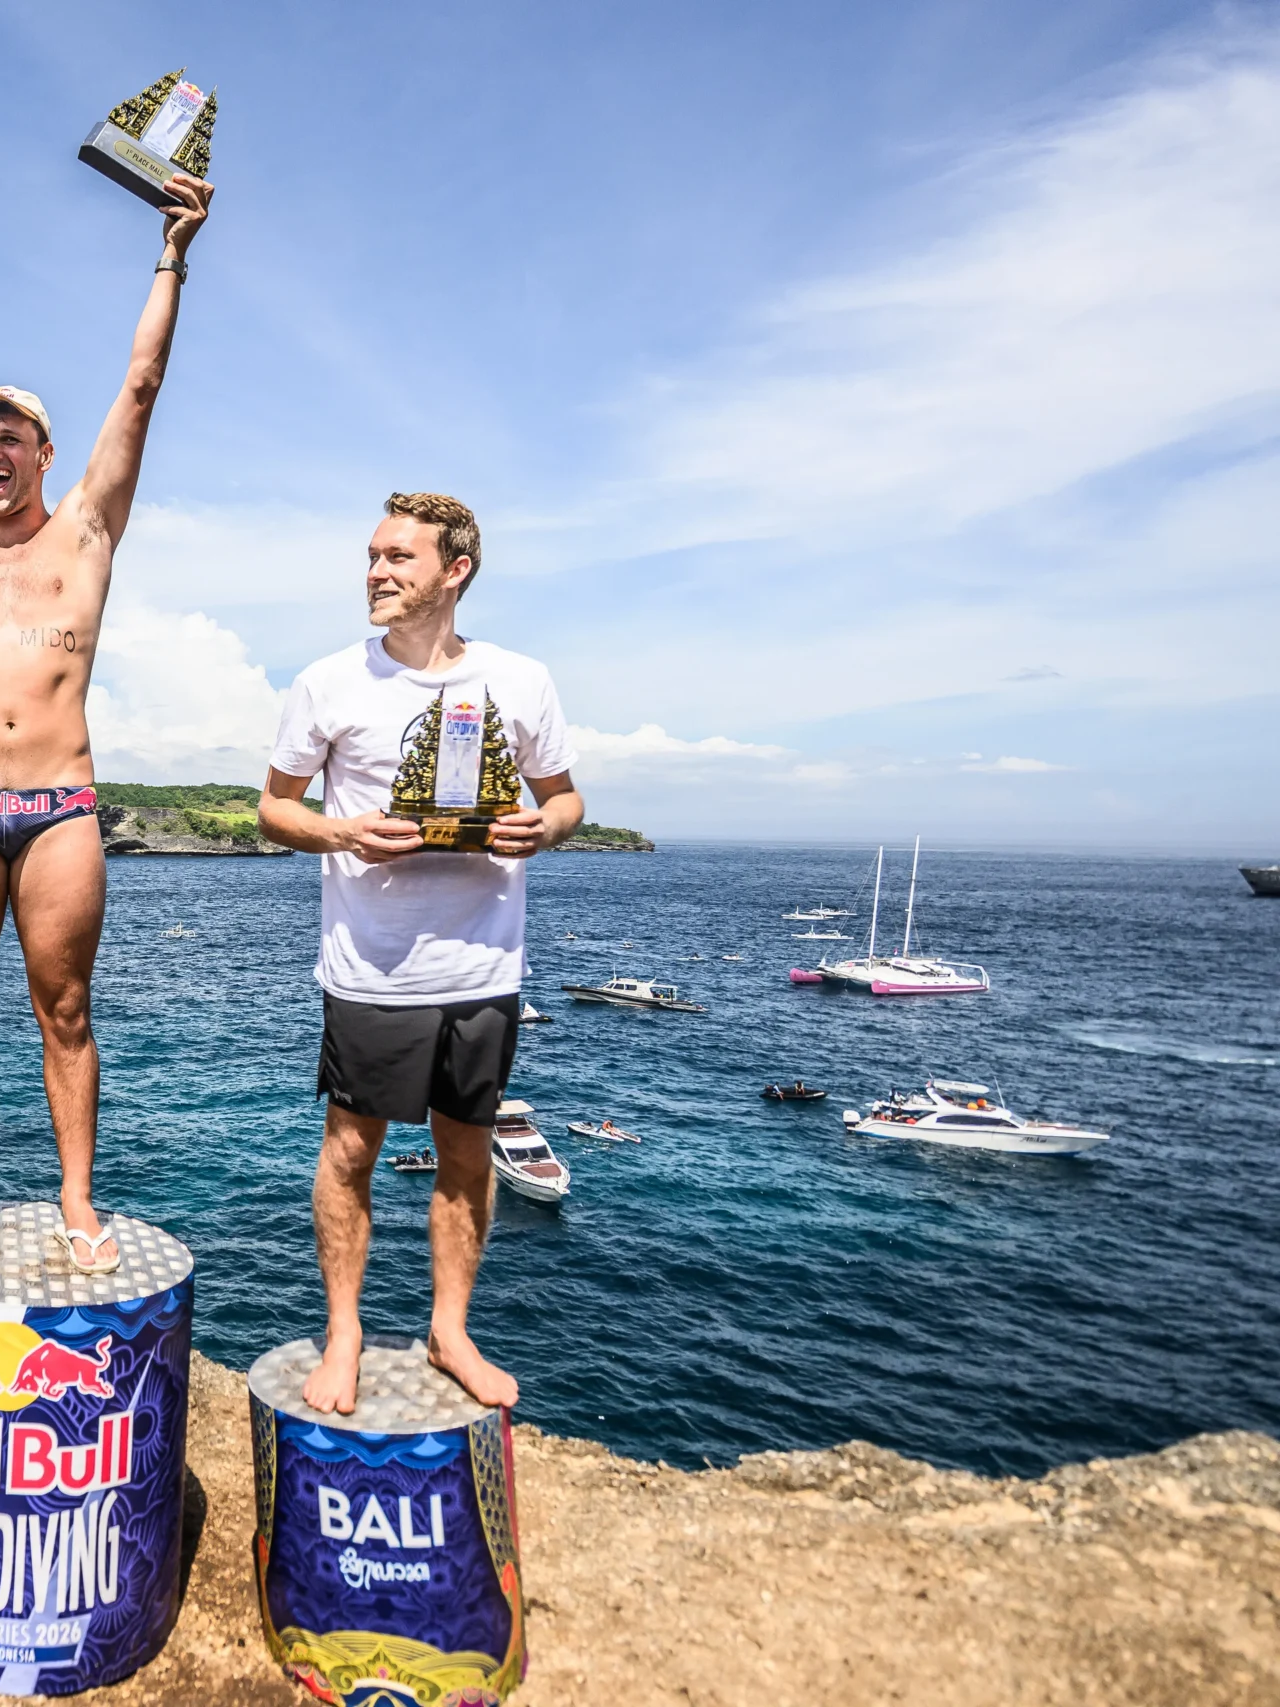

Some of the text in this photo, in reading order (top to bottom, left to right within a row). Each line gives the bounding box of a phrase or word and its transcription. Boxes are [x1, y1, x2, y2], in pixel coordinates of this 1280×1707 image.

[132, 153, 150, 167] PLACE
[149, 164, 164, 177] MALE
[20, 626, 76, 653] MIDO
[446, 712, 482, 722] Red Bull
[6, 793, 51, 815] Bull
[8, 1412, 131, 1492] Bull
[318, 1484, 445, 1549] BALI
[34, 1619, 82, 1645] 2026
